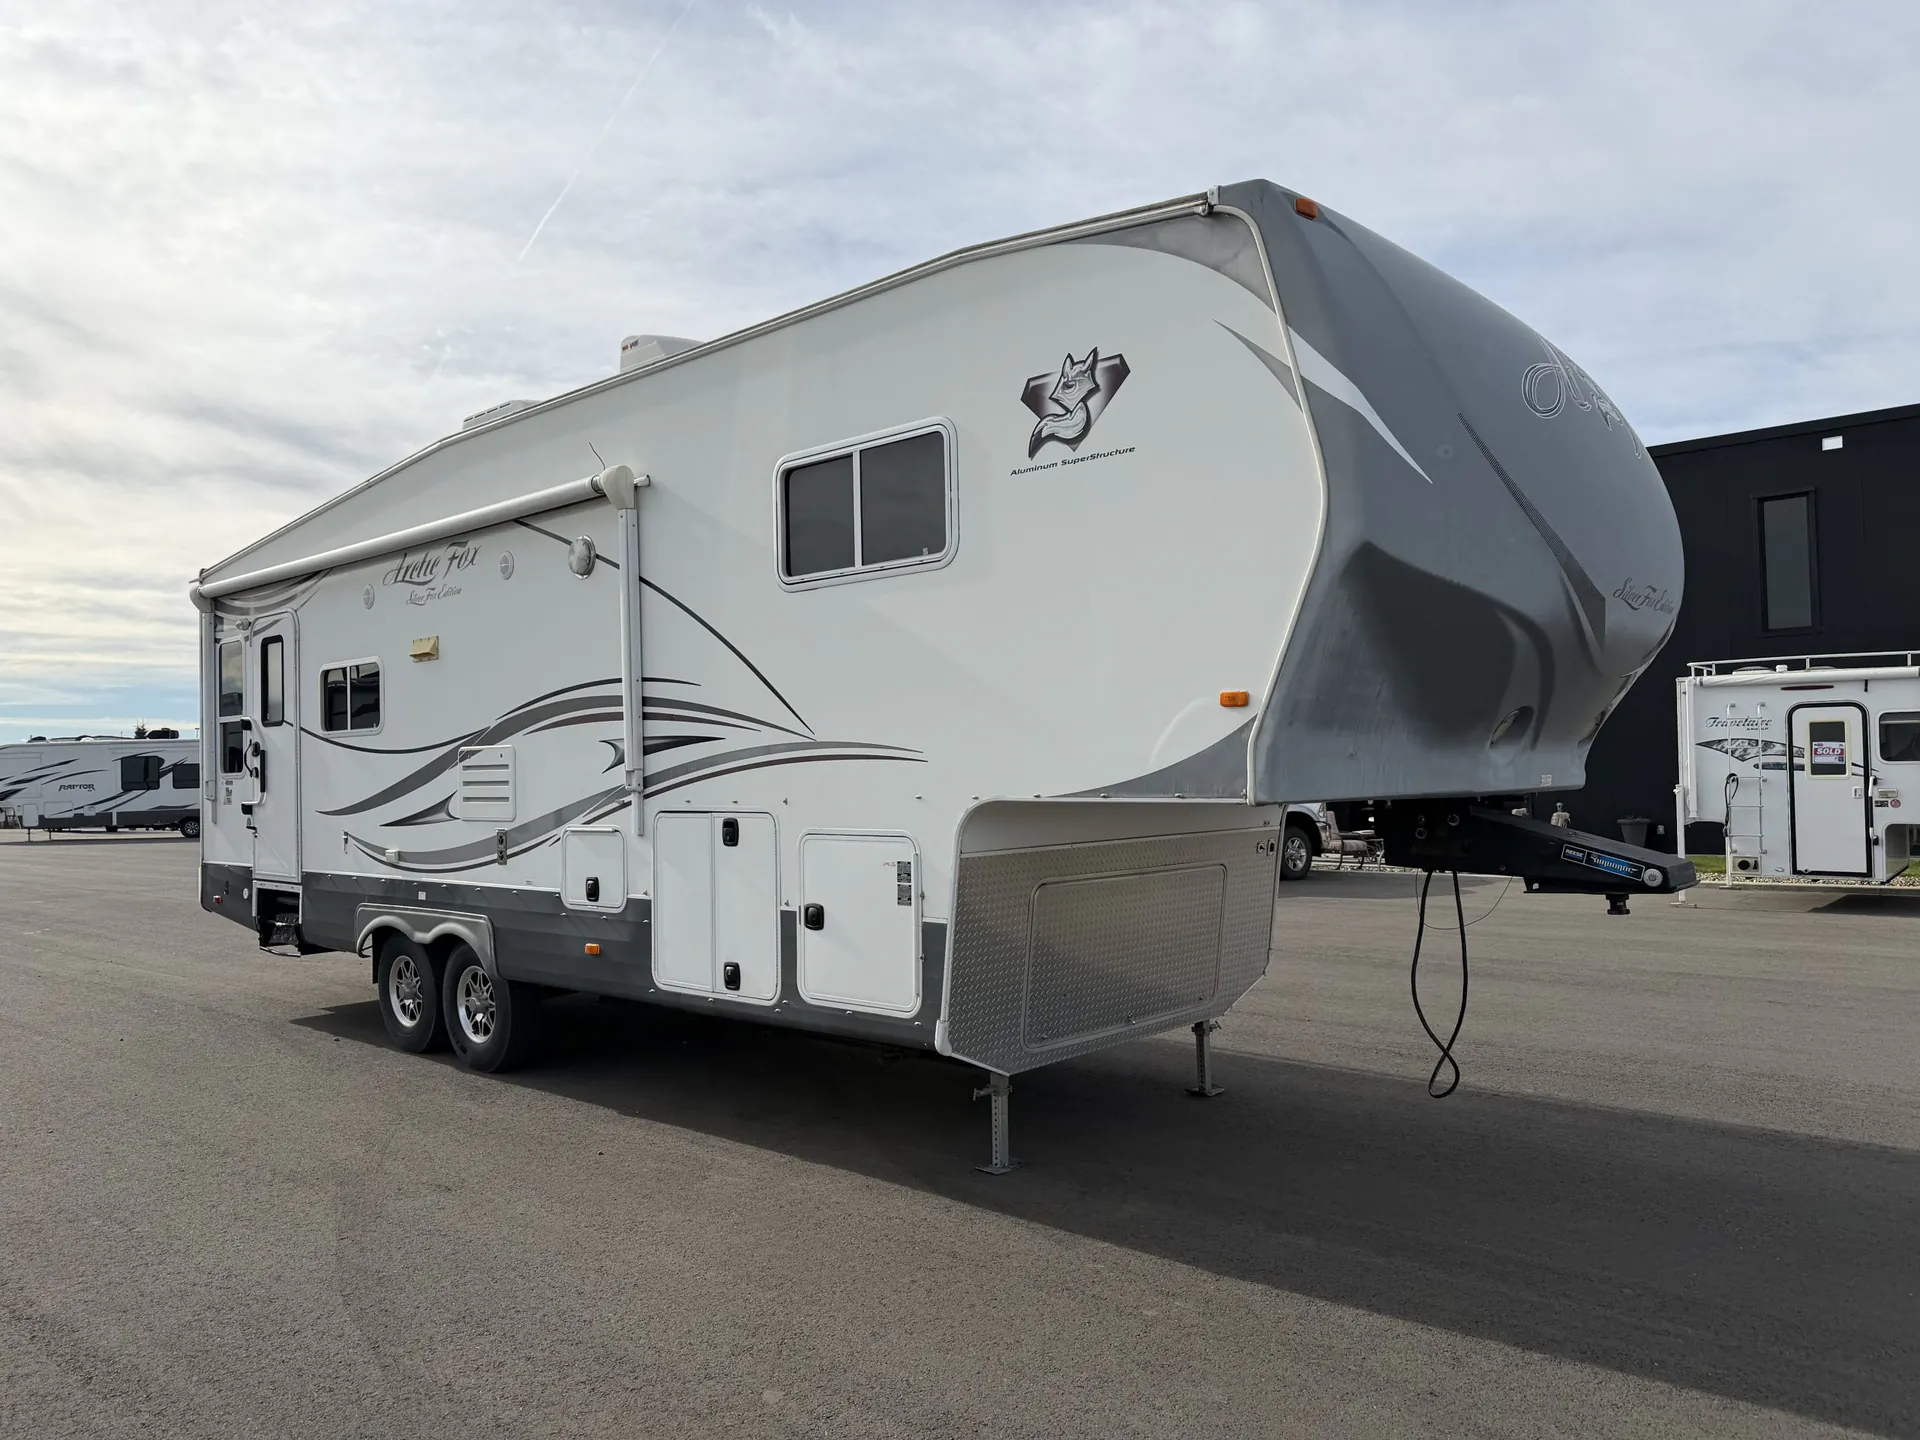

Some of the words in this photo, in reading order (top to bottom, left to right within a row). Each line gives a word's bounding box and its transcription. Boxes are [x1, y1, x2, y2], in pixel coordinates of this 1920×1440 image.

[1010, 461, 1058, 477] Aluminum
[1061, 446, 1136, 466] SuperStructure
[383, 552, 440, 586] Arctic
[442, 541, 482, 579] Fox
[437, 583, 463, 600] Edition
[1816, 747, 1842, 755] SOLD
[58, 783, 96, 792] RAPTOR
[1565, 849, 1584, 858] REESE
